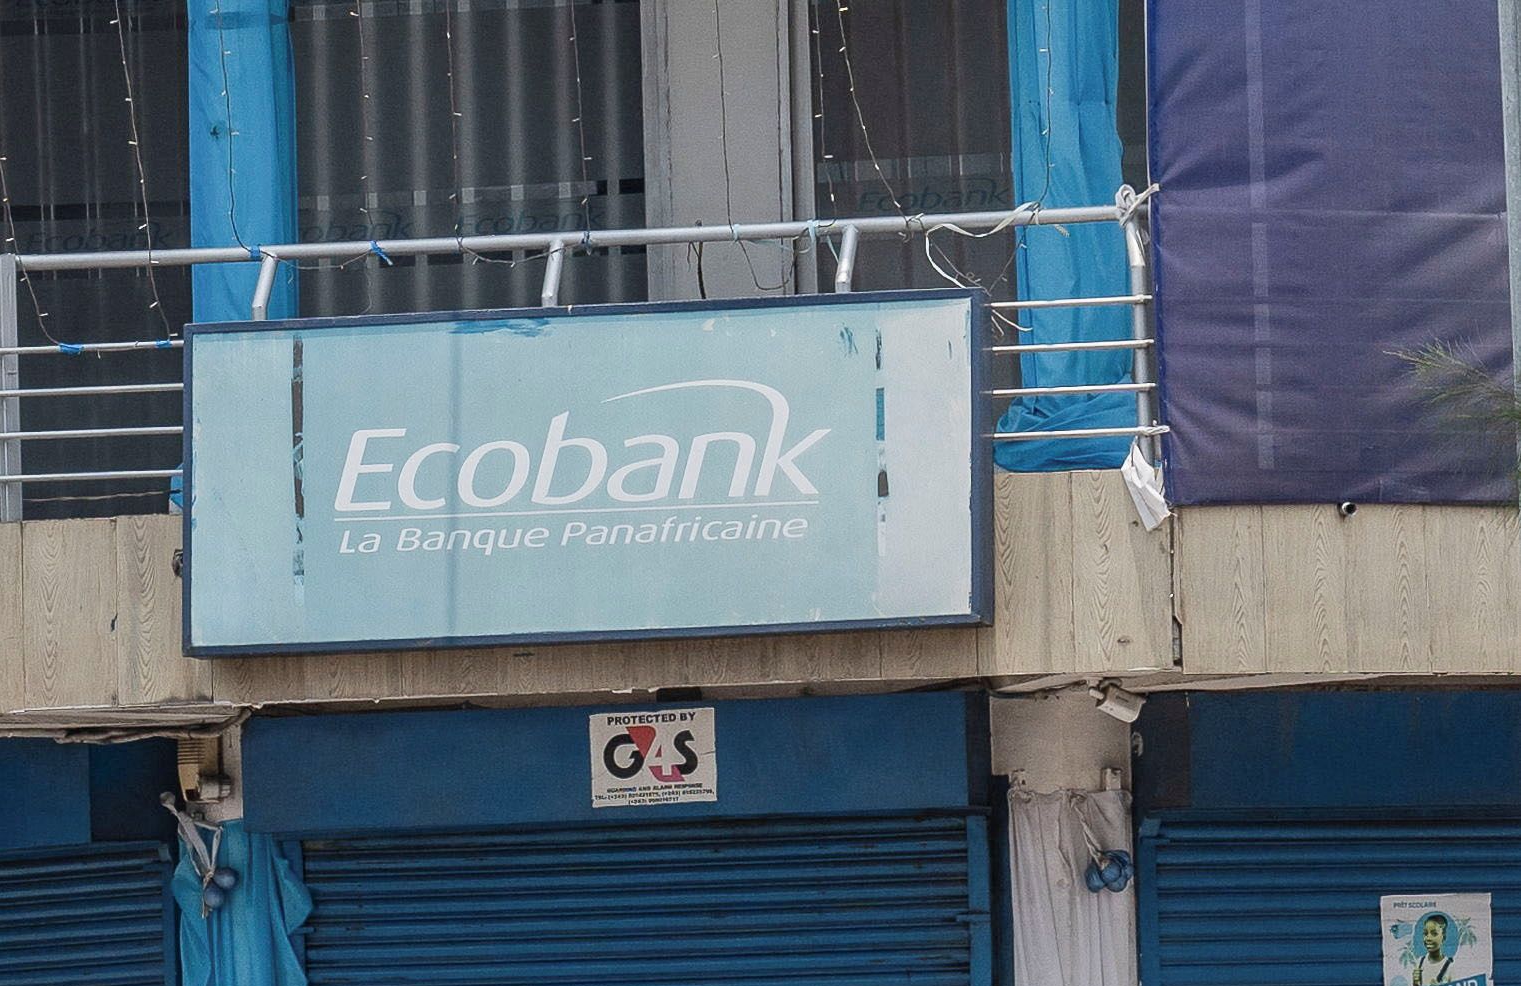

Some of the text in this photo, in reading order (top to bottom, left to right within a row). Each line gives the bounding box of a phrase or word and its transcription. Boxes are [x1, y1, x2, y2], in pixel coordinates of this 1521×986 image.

[859, 175, 1011, 212] Ecobank
[334, 379, 832, 512] Ecobank
[338, 514, 809, 555] La Banque Panafricaine
[607, 711, 696, 726] PROTECTED BY
[603, 726, 699, 782] G4S
